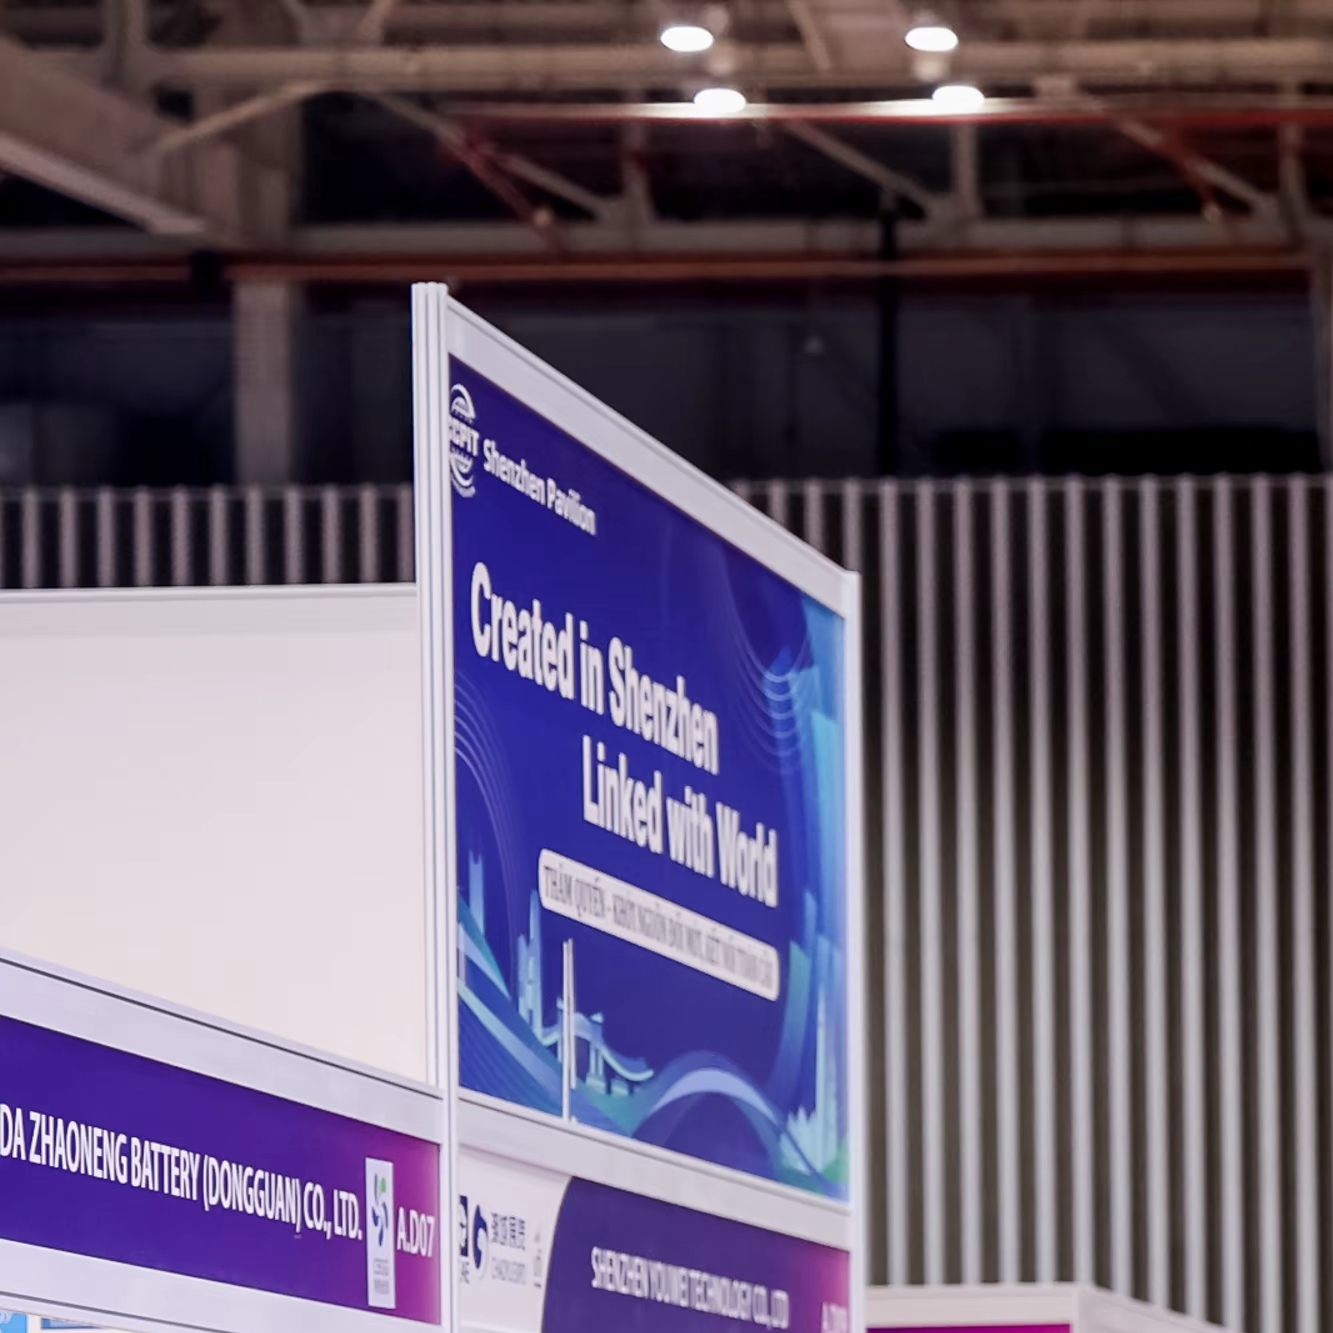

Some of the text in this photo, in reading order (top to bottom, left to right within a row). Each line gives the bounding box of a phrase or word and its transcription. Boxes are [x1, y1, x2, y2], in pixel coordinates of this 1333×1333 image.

[483, 438, 597, 536] Shenzhen Pavilion
[470, 562, 719, 776] Created in Shenzhen
[582, 734, 778, 908] Linked with World
[29, 1111, 128, 1184] ZHAONENG
[131, 1136, 200, 1201] BATTERY
[203, 1154, 300, 1232] (DONGGUAN)
[304, 1182, 331, 1239] CO.,
[334, 1189, 362, 1240] LTD.
[397, 1207, 436, 1257] A.D07
